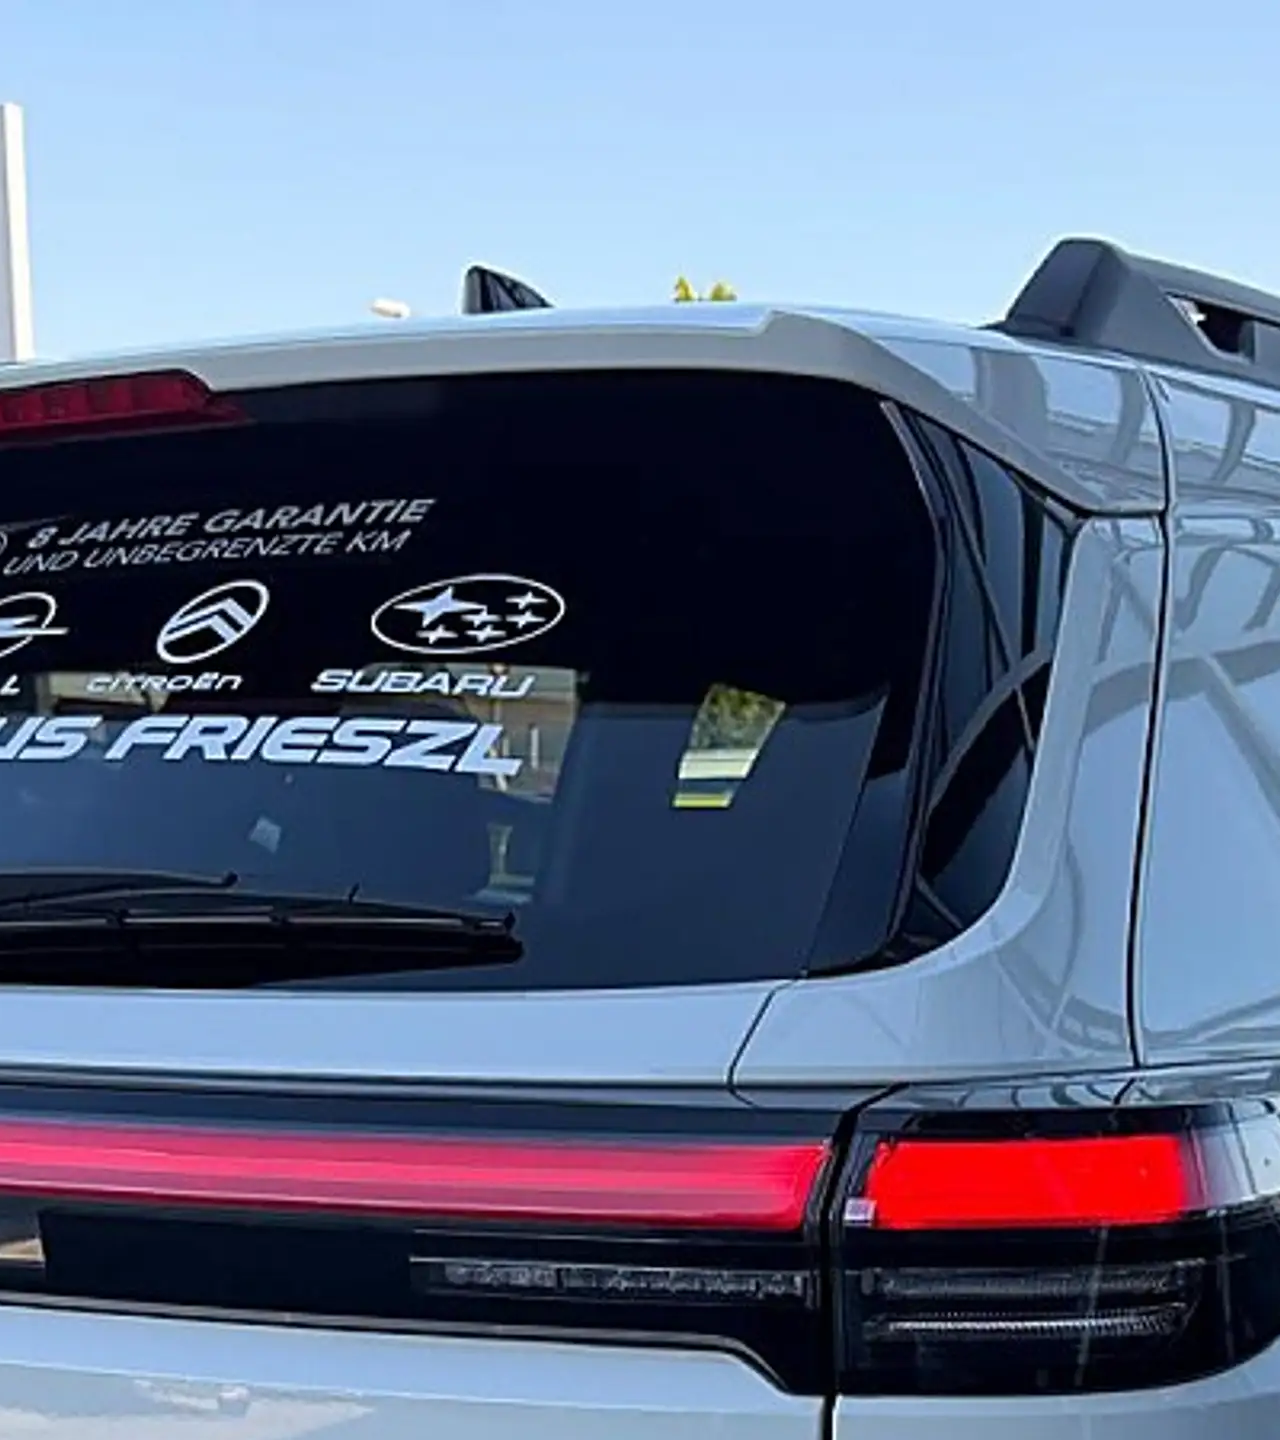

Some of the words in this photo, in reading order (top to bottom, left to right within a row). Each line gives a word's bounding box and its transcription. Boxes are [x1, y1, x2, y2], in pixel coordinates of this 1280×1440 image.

[26, 526, 59, 549] 8
[58, 512, 200, 546] JAHRE
[204, 499, 436, 532] GARANTIE
[2, 549, 80, 577] UND
[82, 531, 344, 569] UNBEGRENZTE
[345, 528, 412, 553] KM
[310, 668, 536, 698] SUBARU
[104, 715, 524, 777] FRIESZL
